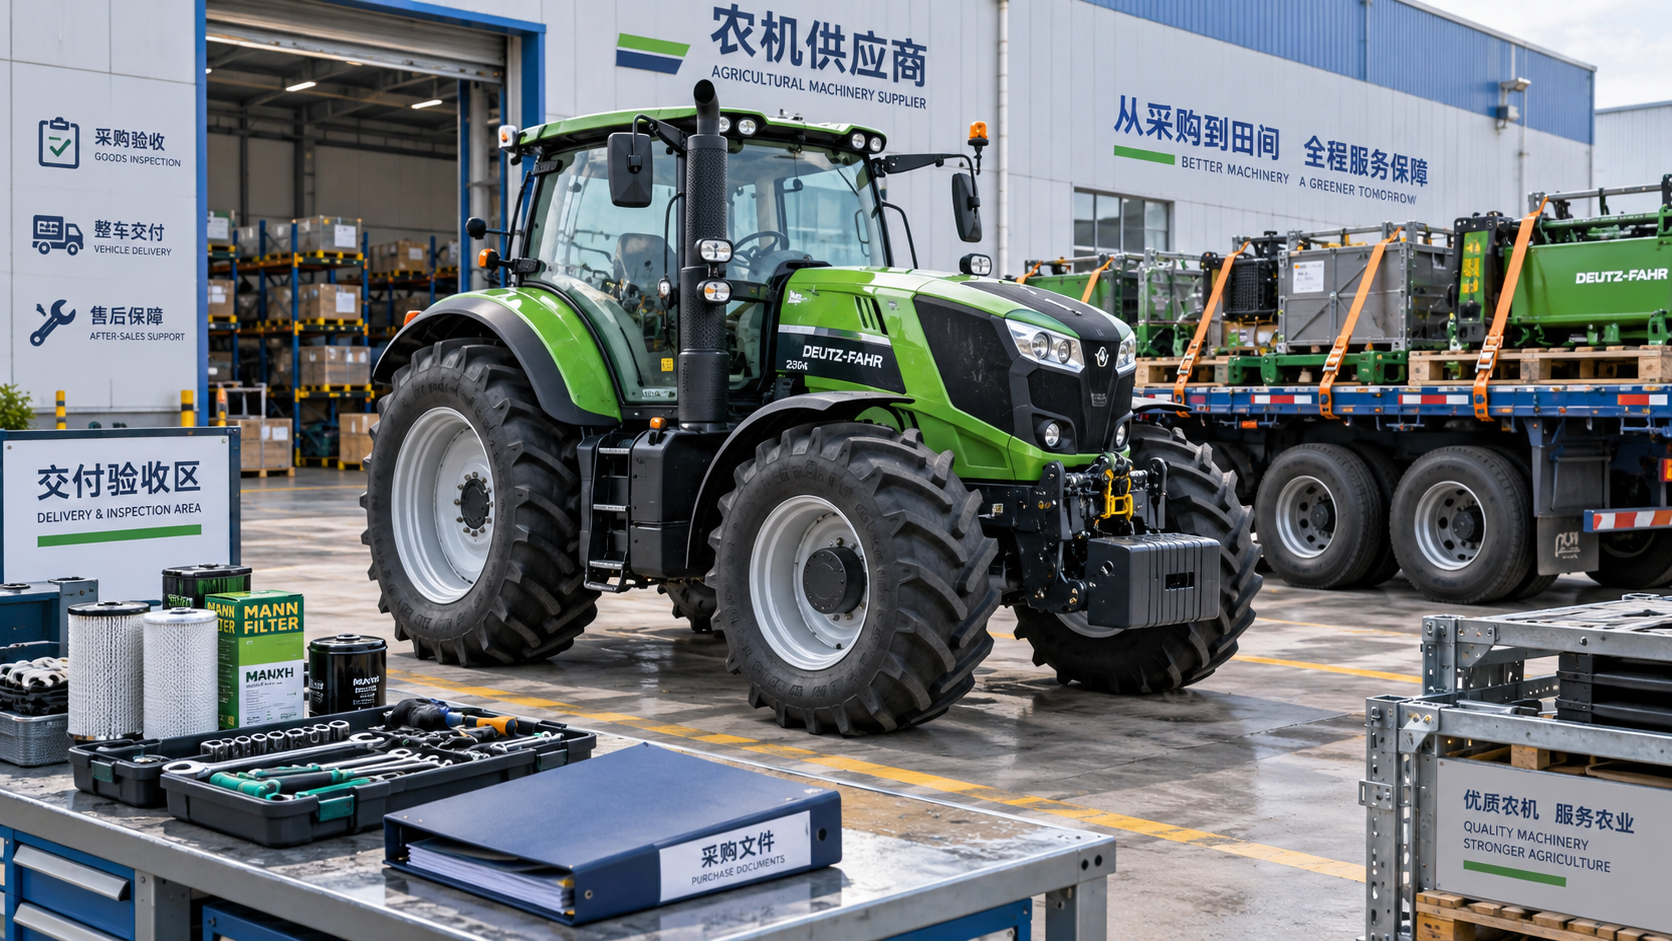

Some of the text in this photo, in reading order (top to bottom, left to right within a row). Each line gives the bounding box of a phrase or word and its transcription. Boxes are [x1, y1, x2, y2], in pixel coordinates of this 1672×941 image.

[711, 3, 927, 87] 农机供应商
[711, 64, 927, 110] AGRICULTURAL MACHINERY SUPPLIER
[95, 128, 165, 151] 采购验收
[1114, 95, 1428, 187] 从采购到田间 全程服务保障
[94, 152, 181, 167] GOODS INSPECTION
[1182, 156, 1417, 205] BETTER MACHINERY A GREENER TOMORROW
[94, 220, 164, 241] 整车交付
[94, 245, 172, 256] VEHICLE DELIVERY
[1575, 268, 1668, 284] DEUTZ-FAHR
[90, 306, 163, 326] 售后保障
[90, 332, 185, 341] AFTER-SALES SUPPORT
[802, 345, 883, 368] DEUTZ-FAHR
[38, 461, 201, 500] 交付验收区
[37, 503, 201, 523] DELIVERY & INSPECTION AREA
[244, 601, 298, 619] MANN
[217, 617, 235, 634] TER
[244, 617, 298, 634] FILTER
[1464, 789, 1634, 834] 优质农机 服务农业
[1464, 820, 1589, 851] QUALITY MACHINERY
[702, 830, 774, 867] 采购文件
[1464, 838, 1611, 873] STRONGER AGRICULTURE
[692, 855, 785, 885] PURCHASE DOCUMENTS
